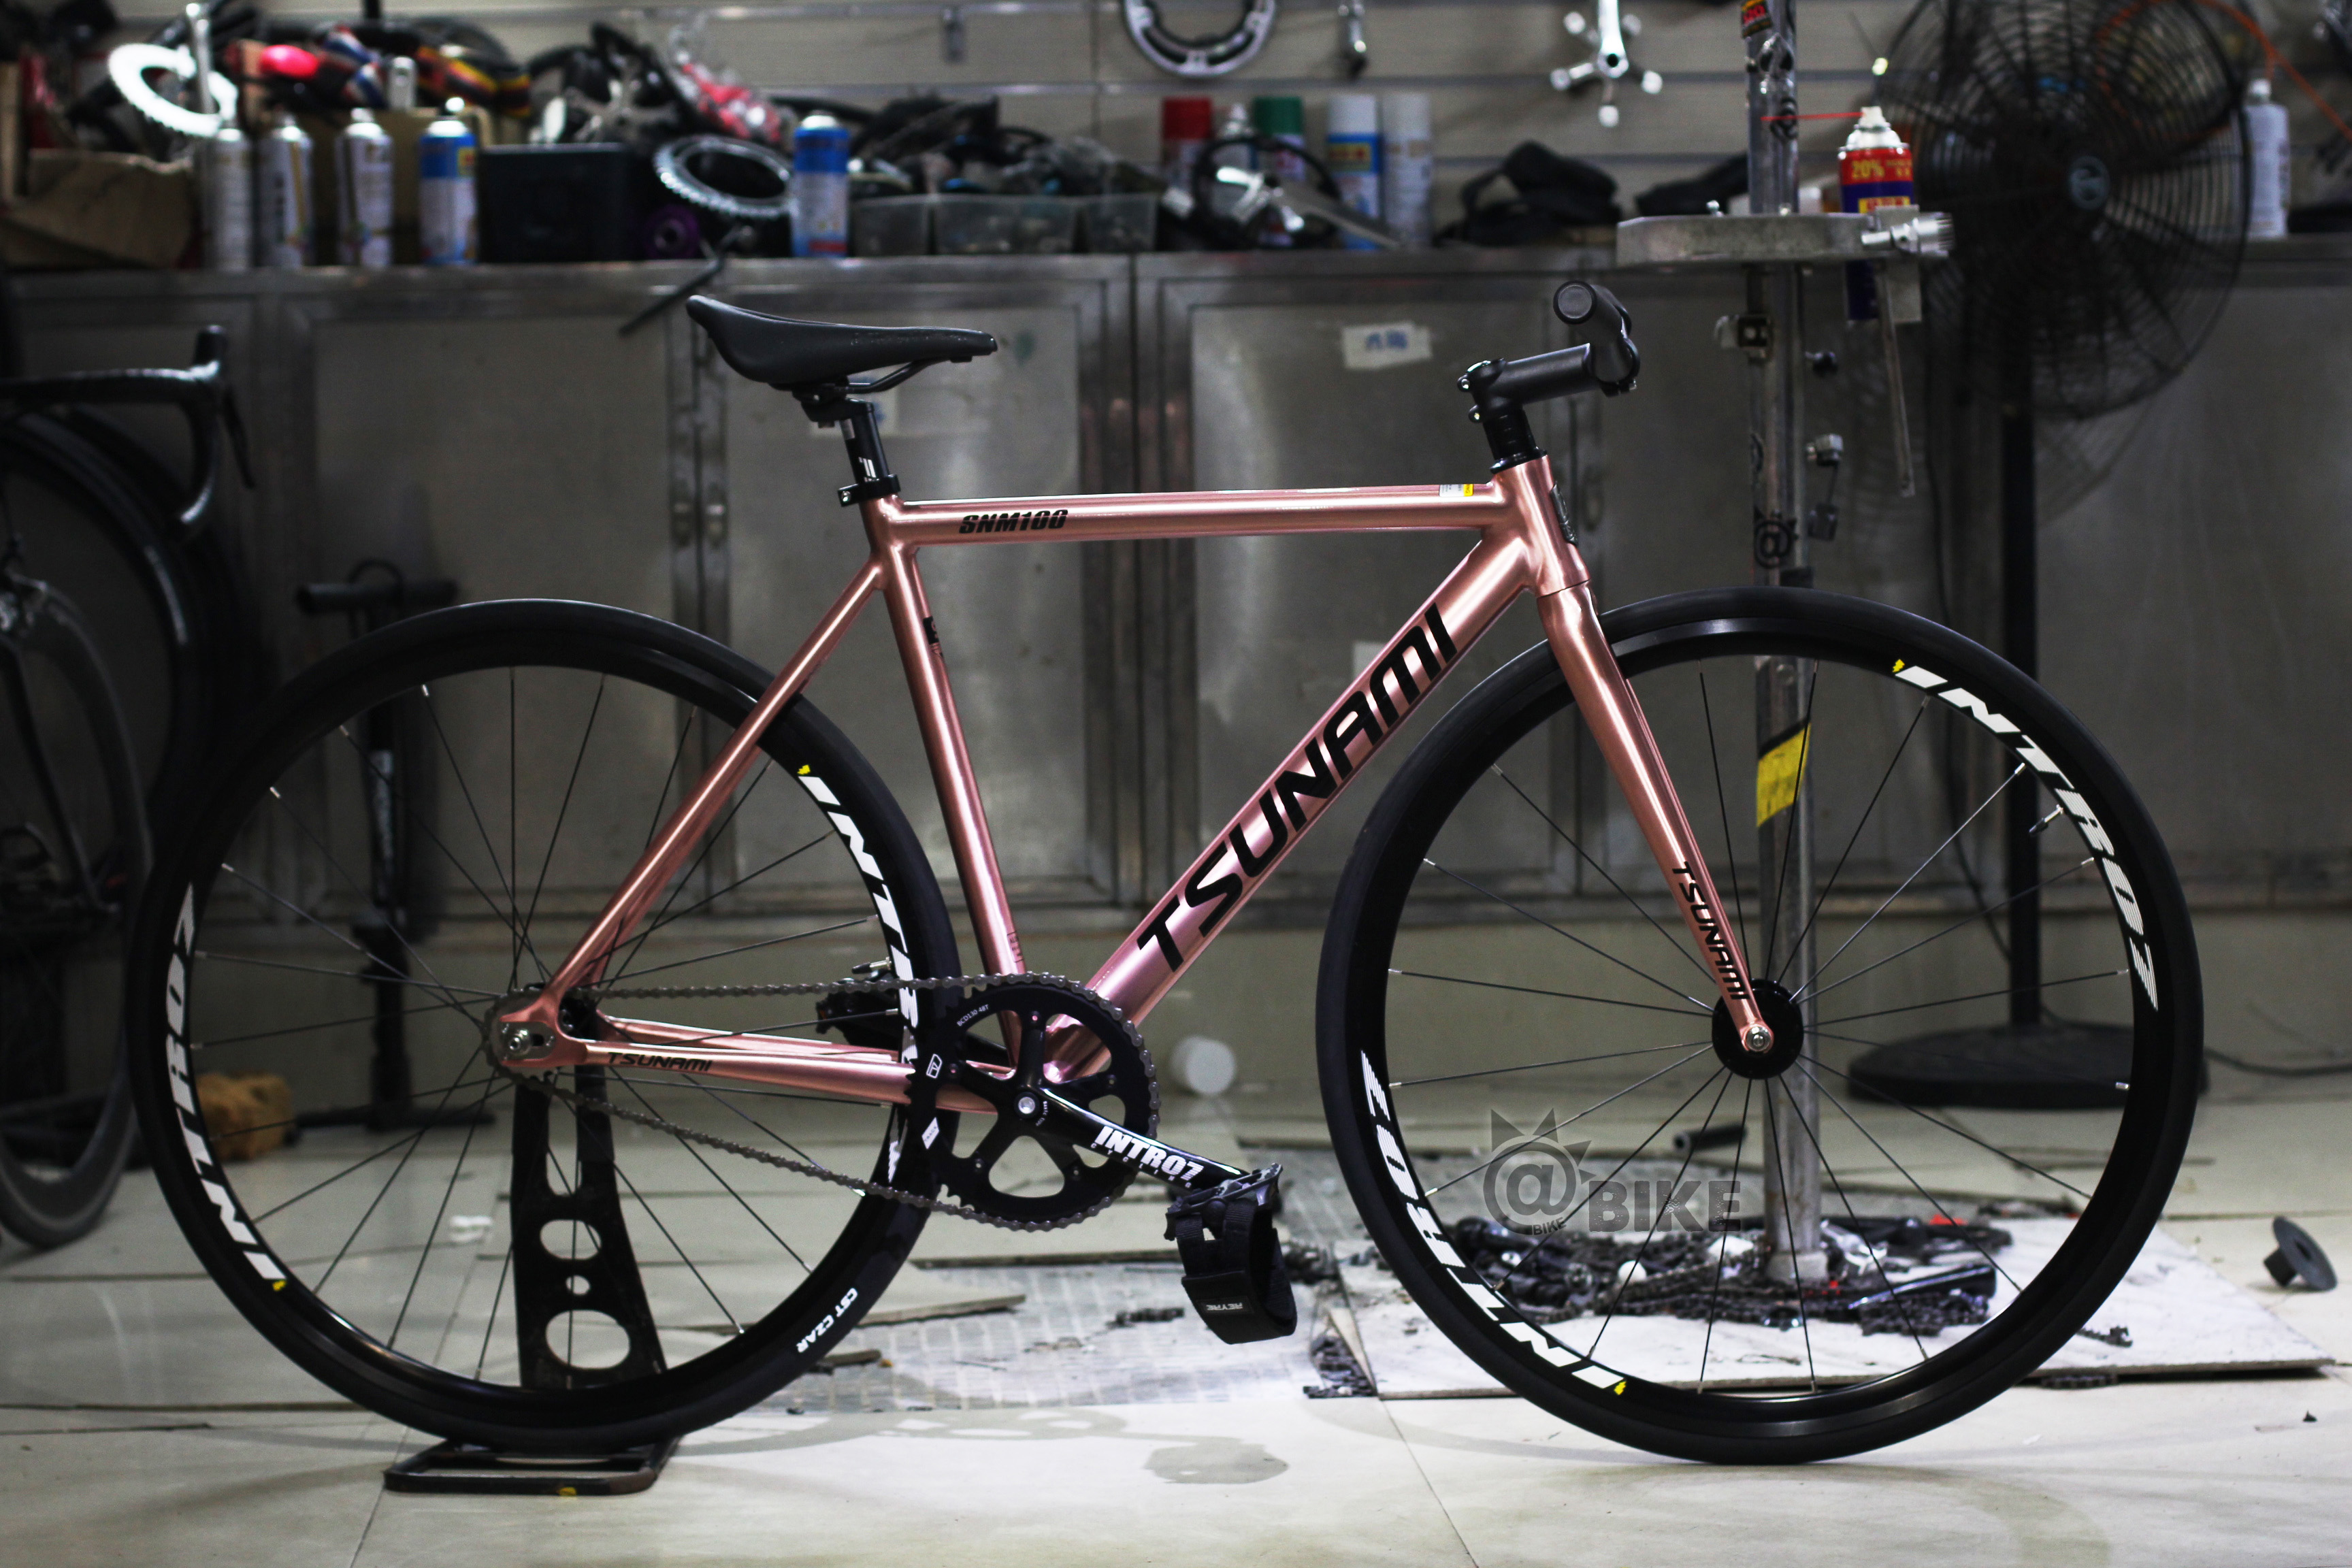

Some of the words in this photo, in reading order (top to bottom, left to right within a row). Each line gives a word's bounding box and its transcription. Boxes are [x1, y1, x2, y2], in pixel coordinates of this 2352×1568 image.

[959, 509, 1068, 534] SNM100
[1137, 603, 1458, 972] TSUNAMI
[1672, 861, 1750, 1000] TSUNAMI
[608, 1051, 713, 1072] TSUNAMI
[1094, 1126, 1205, 1181] INTRO7
[834, 1288, 858, 1318] CST
[796, 1314, 834, 1353] CZAR
